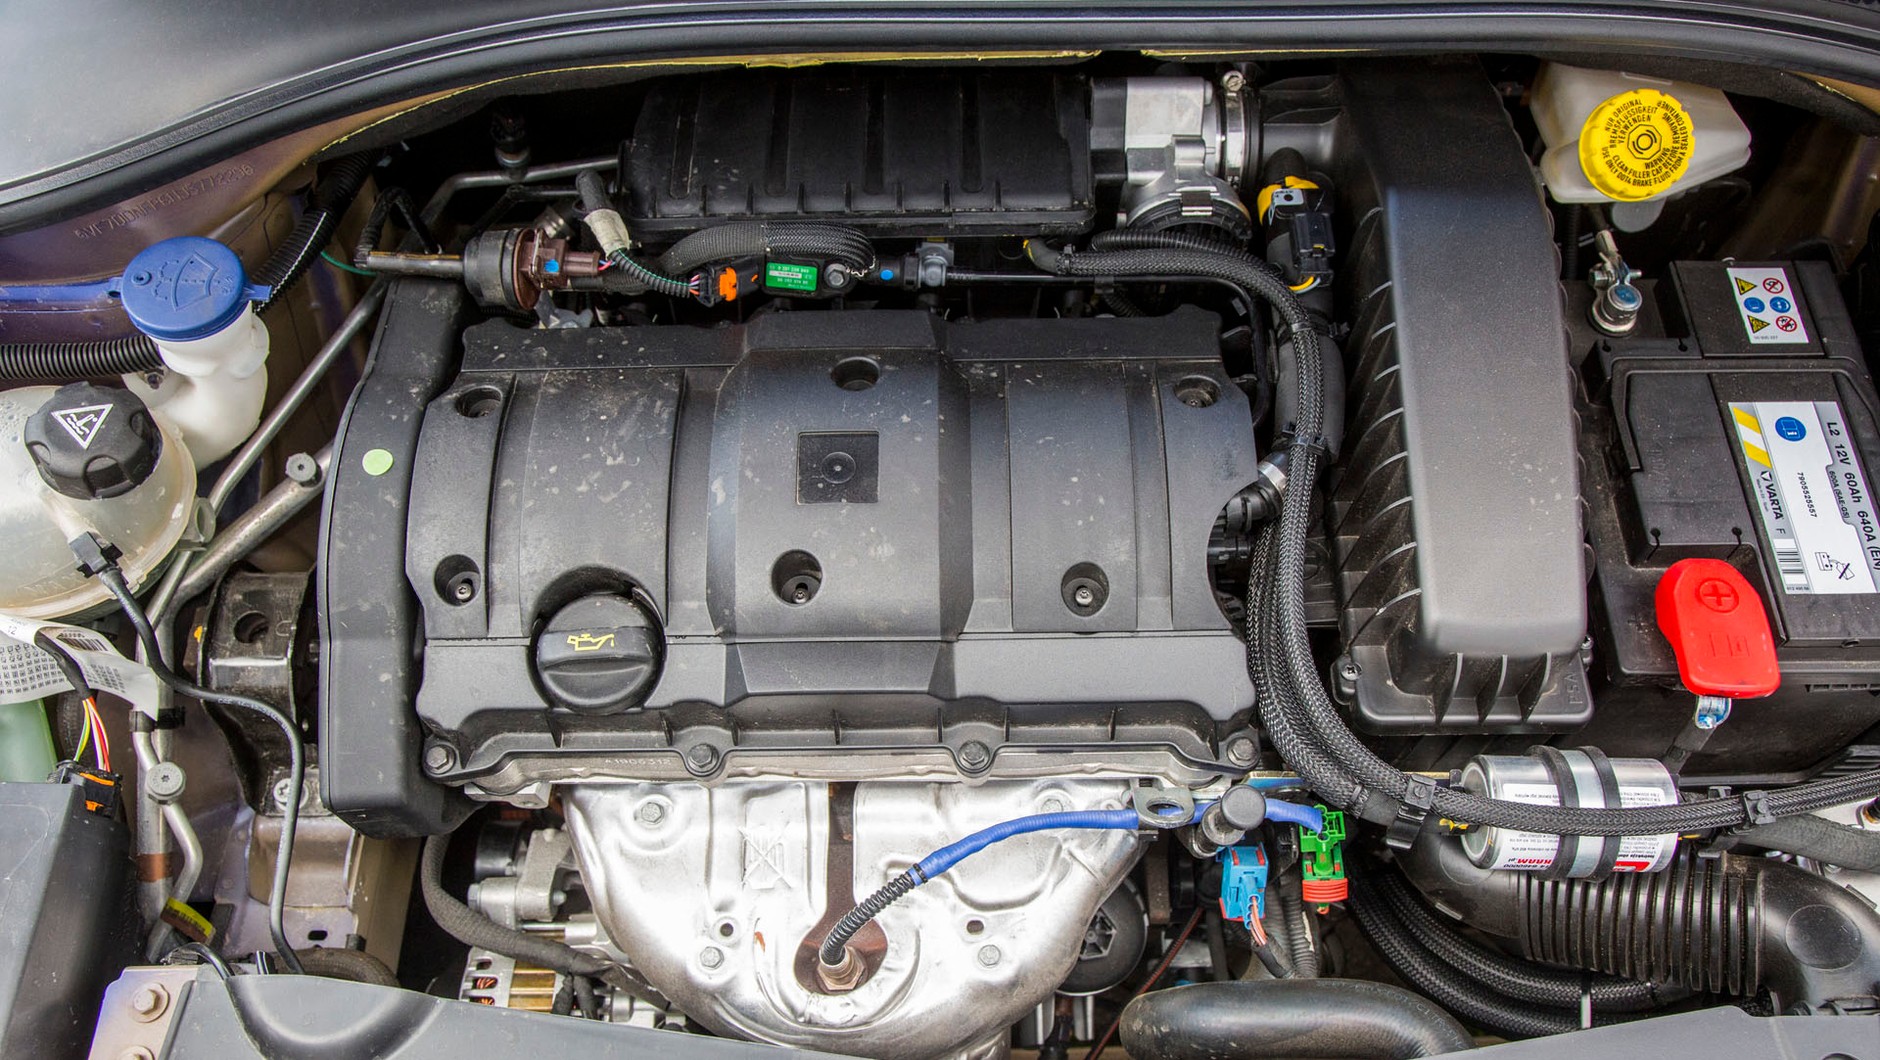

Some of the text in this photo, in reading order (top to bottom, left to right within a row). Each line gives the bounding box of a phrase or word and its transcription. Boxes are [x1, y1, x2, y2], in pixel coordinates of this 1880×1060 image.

[1605, 99, 1642, 131] NUR ORIGINAL
[1657, 100, 1685, 127] CONTAINER
[1618, 114, 1652, 144] VERWENDEN
[1680, 125, 1689, 151] SEALED
[1602, 146, 1611, 159] USE
[1612, 112, 1680, 179] CLEAN FILLER CAP BEFORE REMOVING
[1644, 147, 1671, 169] WARNING
[1605, 159, 1619, 175] ONLY
[1653, 169, 1672, 184] FLUID
[1669, 155, 1684, 174] FROM
[1632, 178, 1653, 187] BRAKE
[1796, 472, 1818, 517] 7905525557
[1827, 421, 1840, 437] L2
[1835, 443, 1851, 466] 12V
[1844, 472, 1863, 503] 60Ah
[1857, 510, 1877, 542] 640A
[1765, 483, 1784, 520] VARTA
